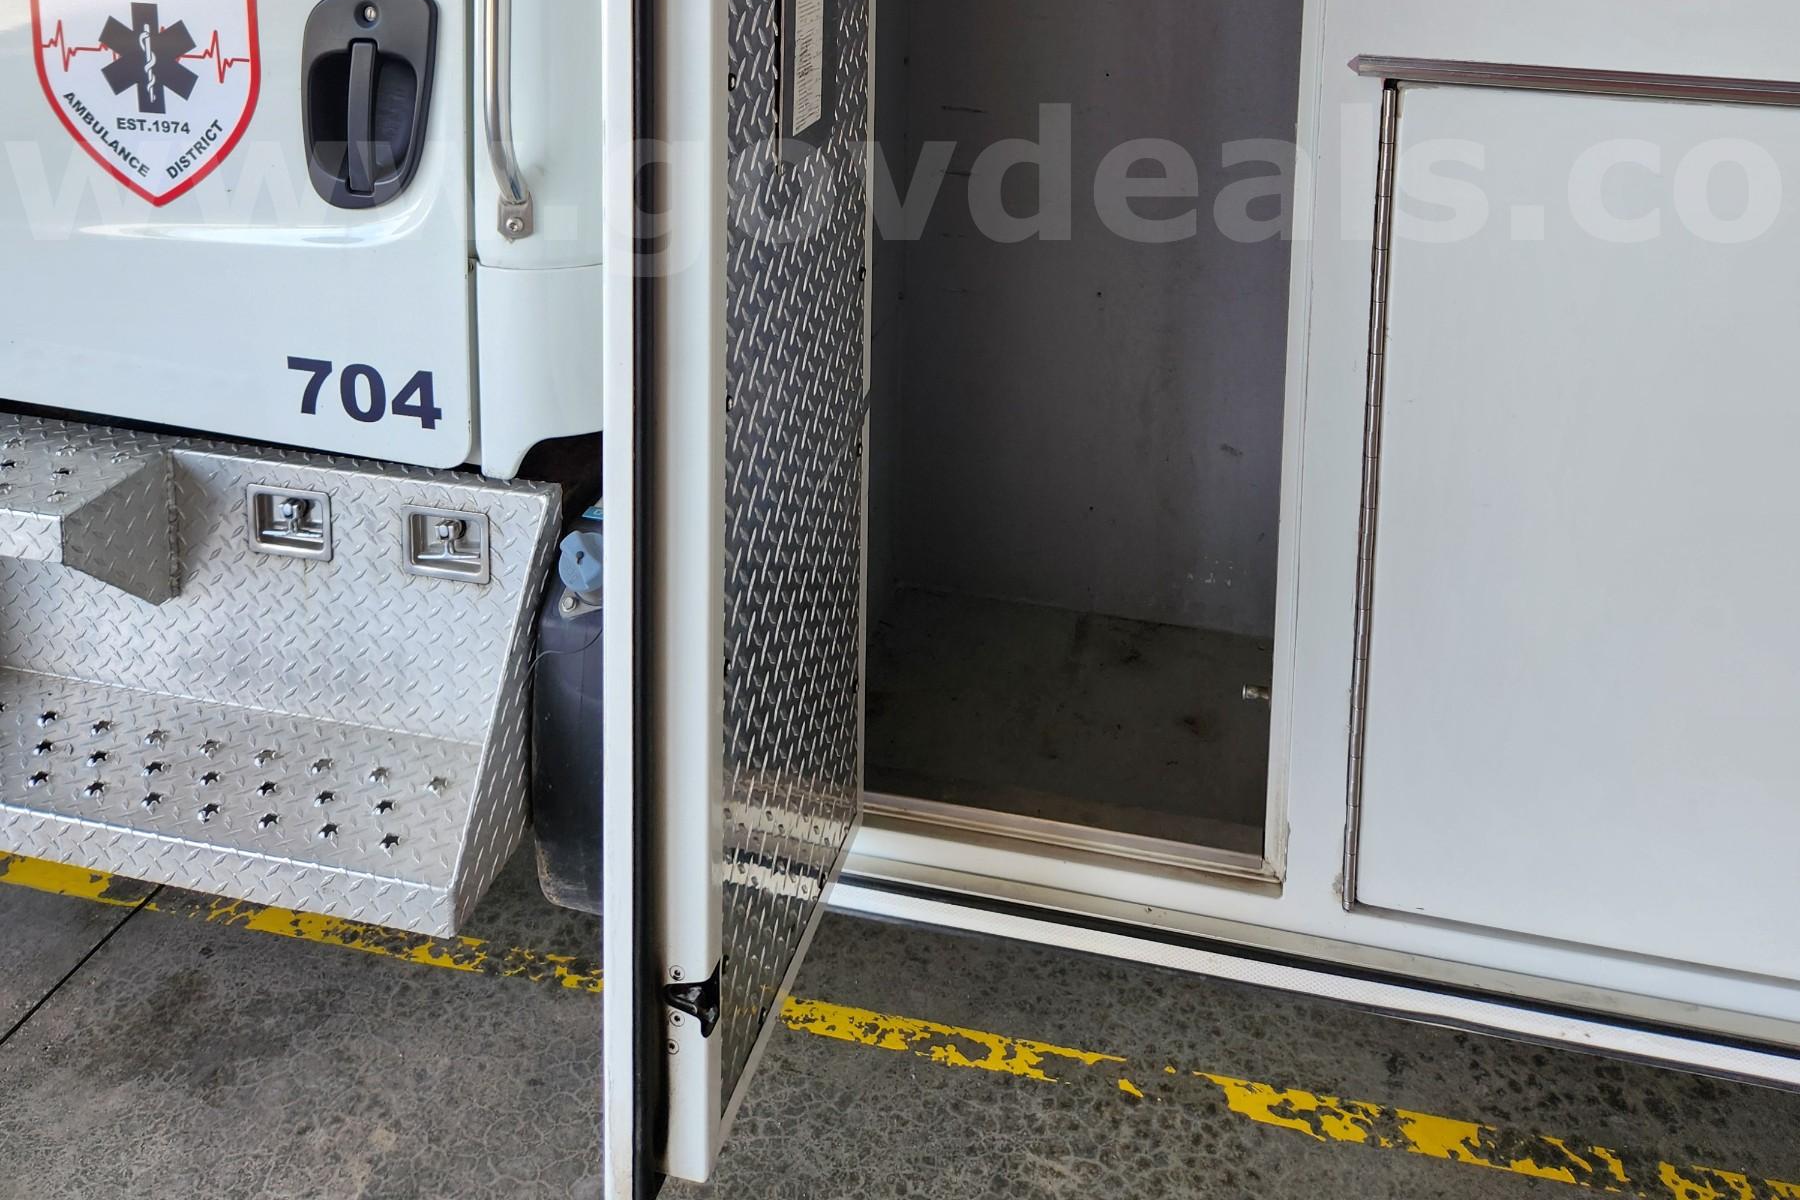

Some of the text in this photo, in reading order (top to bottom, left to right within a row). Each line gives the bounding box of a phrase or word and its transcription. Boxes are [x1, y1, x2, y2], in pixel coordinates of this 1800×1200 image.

[63, 91, 223, 179] AMBULANCE DISTRICT
[287, 356, 442, 429] 704
